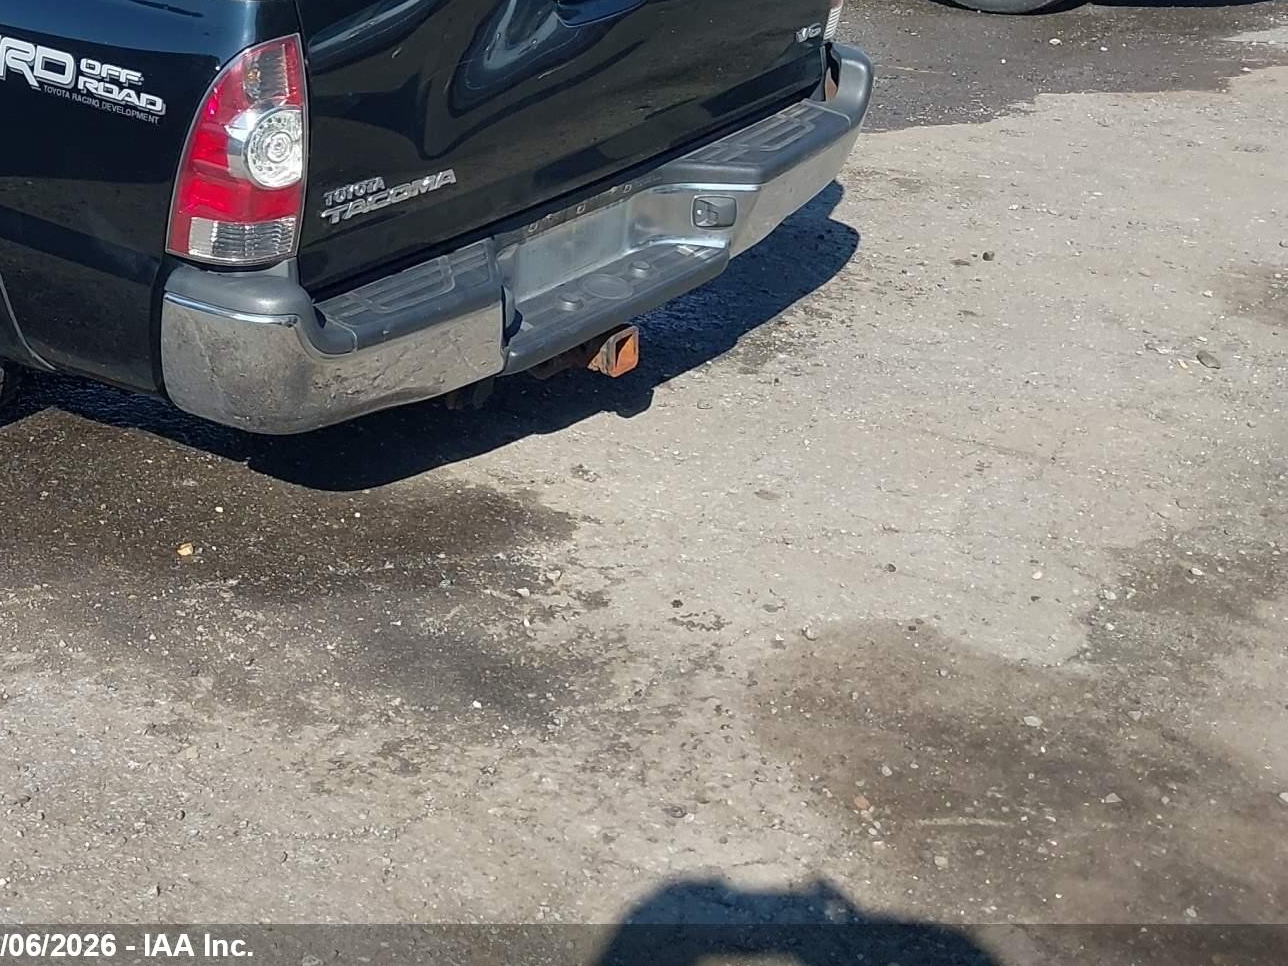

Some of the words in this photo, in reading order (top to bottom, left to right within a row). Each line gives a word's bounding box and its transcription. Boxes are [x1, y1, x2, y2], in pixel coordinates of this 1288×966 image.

[79, 58, 144, 86] OFF
[43, 84, 71, 100] TOYOTA
[72, 92, 101, 109] RACING
[101, 101, 160, 125] DEVELOPMENT
[77, 75, 166, 115] ROAD
[320, 168, 457, 225] TACOMA
[323, 176, 386, 206] TOYOTA
